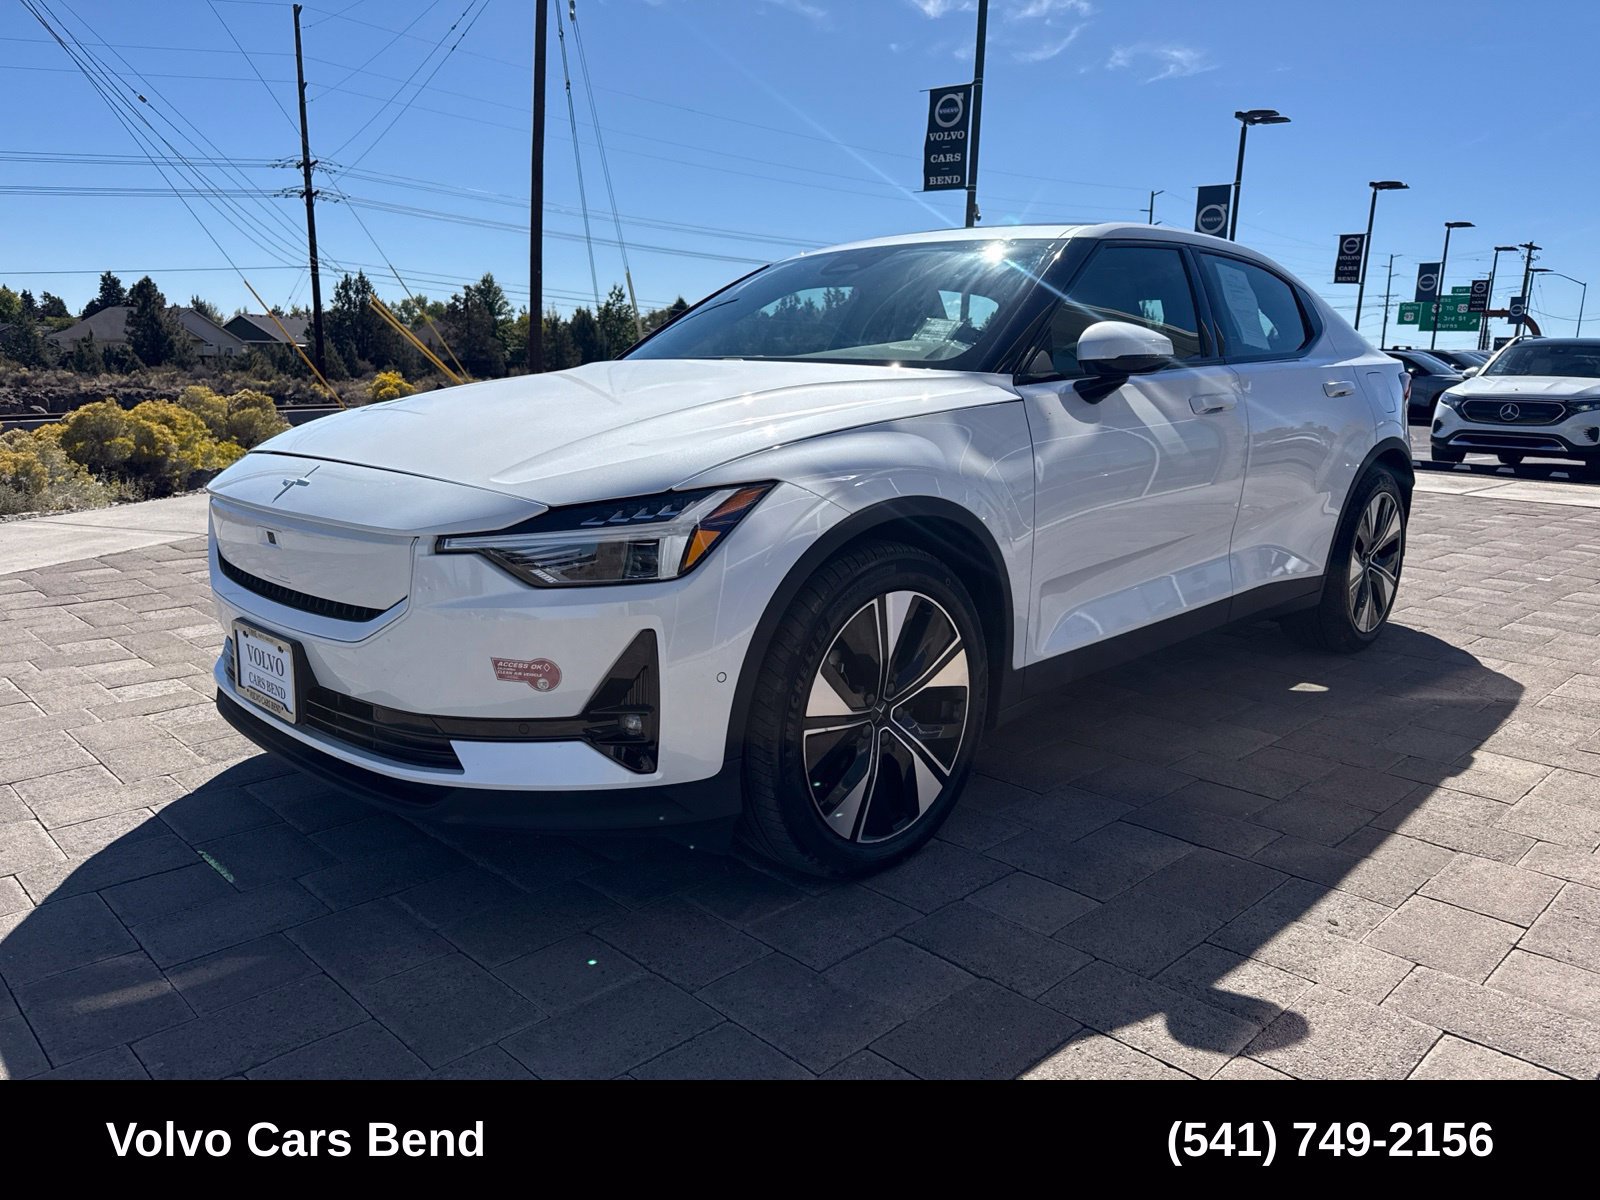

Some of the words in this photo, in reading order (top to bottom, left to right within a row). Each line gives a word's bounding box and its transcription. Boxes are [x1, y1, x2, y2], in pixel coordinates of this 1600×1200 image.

[929, 130, 965, 142] VOLVO
[930, 153, 962, 163] CARS
[929, 175, 961, 185] BEND
[246, 643, 285, 677] VOLVO
[497, 661, 529, 669] ACCESS
[248, 671, 266, 690] CARS
[266, 681, 286, 700] BEND
